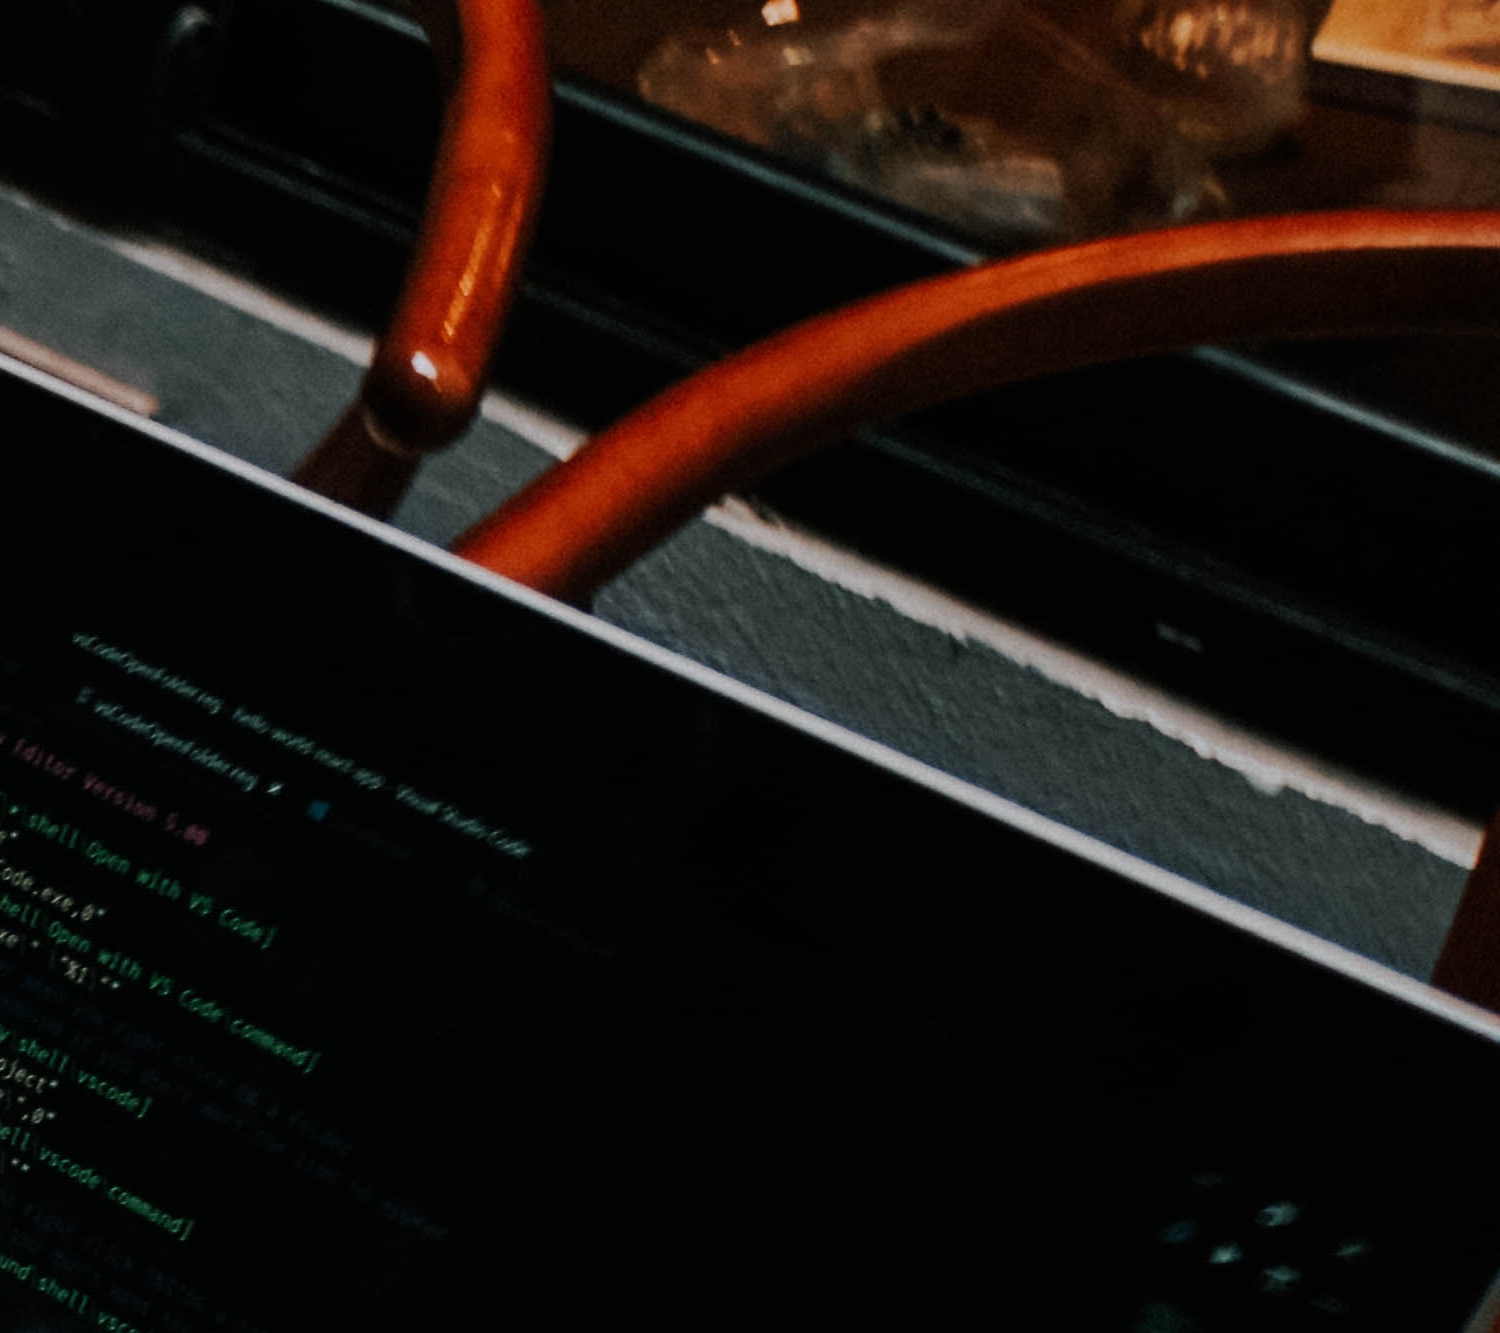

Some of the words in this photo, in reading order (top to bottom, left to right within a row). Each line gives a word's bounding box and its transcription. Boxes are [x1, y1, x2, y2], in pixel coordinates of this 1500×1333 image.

[135, 869, 181, 899] with
[188, 892, 212, 916] VS
[96, 949, 141, 979] with
[148, 973, 172, 996] VS
